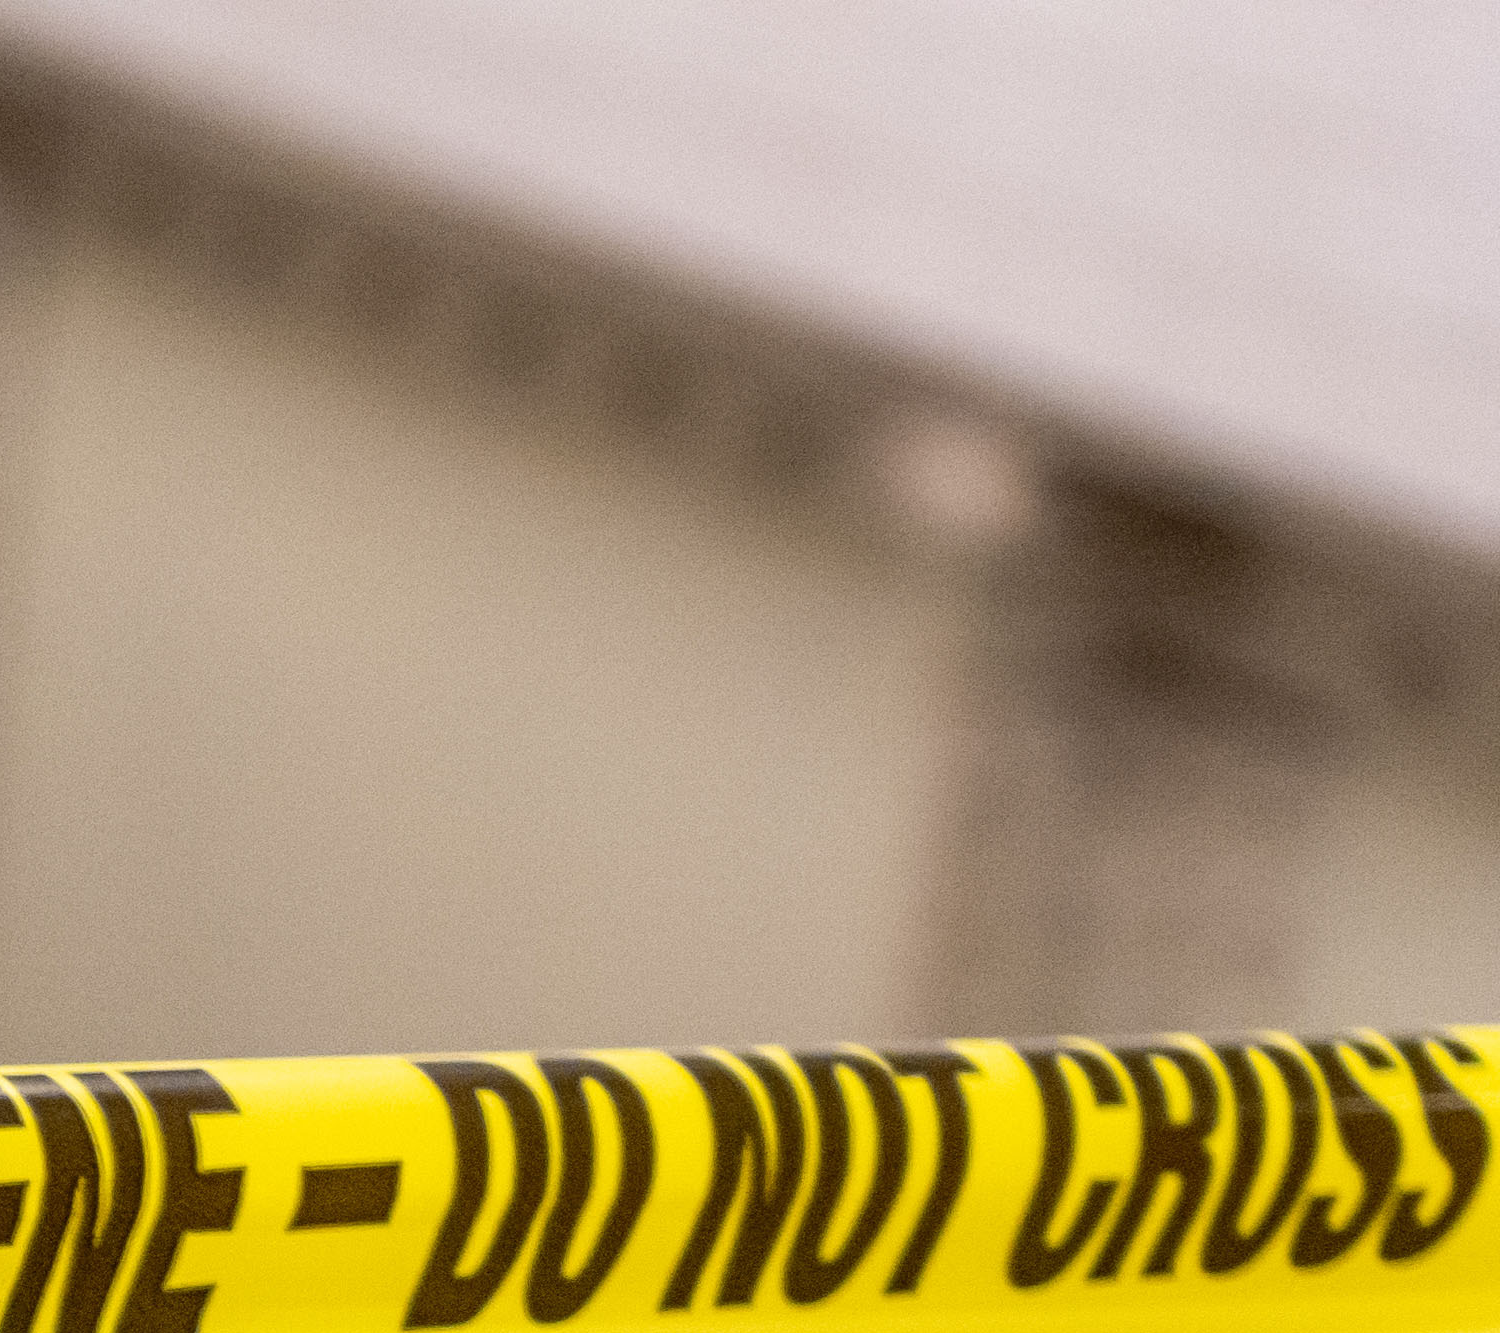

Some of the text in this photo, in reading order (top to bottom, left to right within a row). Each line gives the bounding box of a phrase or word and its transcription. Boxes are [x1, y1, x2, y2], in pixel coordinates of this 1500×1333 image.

[399, 1058, 658, 1333] DO
[654, 1050, 982, 1314] NOT
[1005, 1036, 1493, 1292] CROSS
